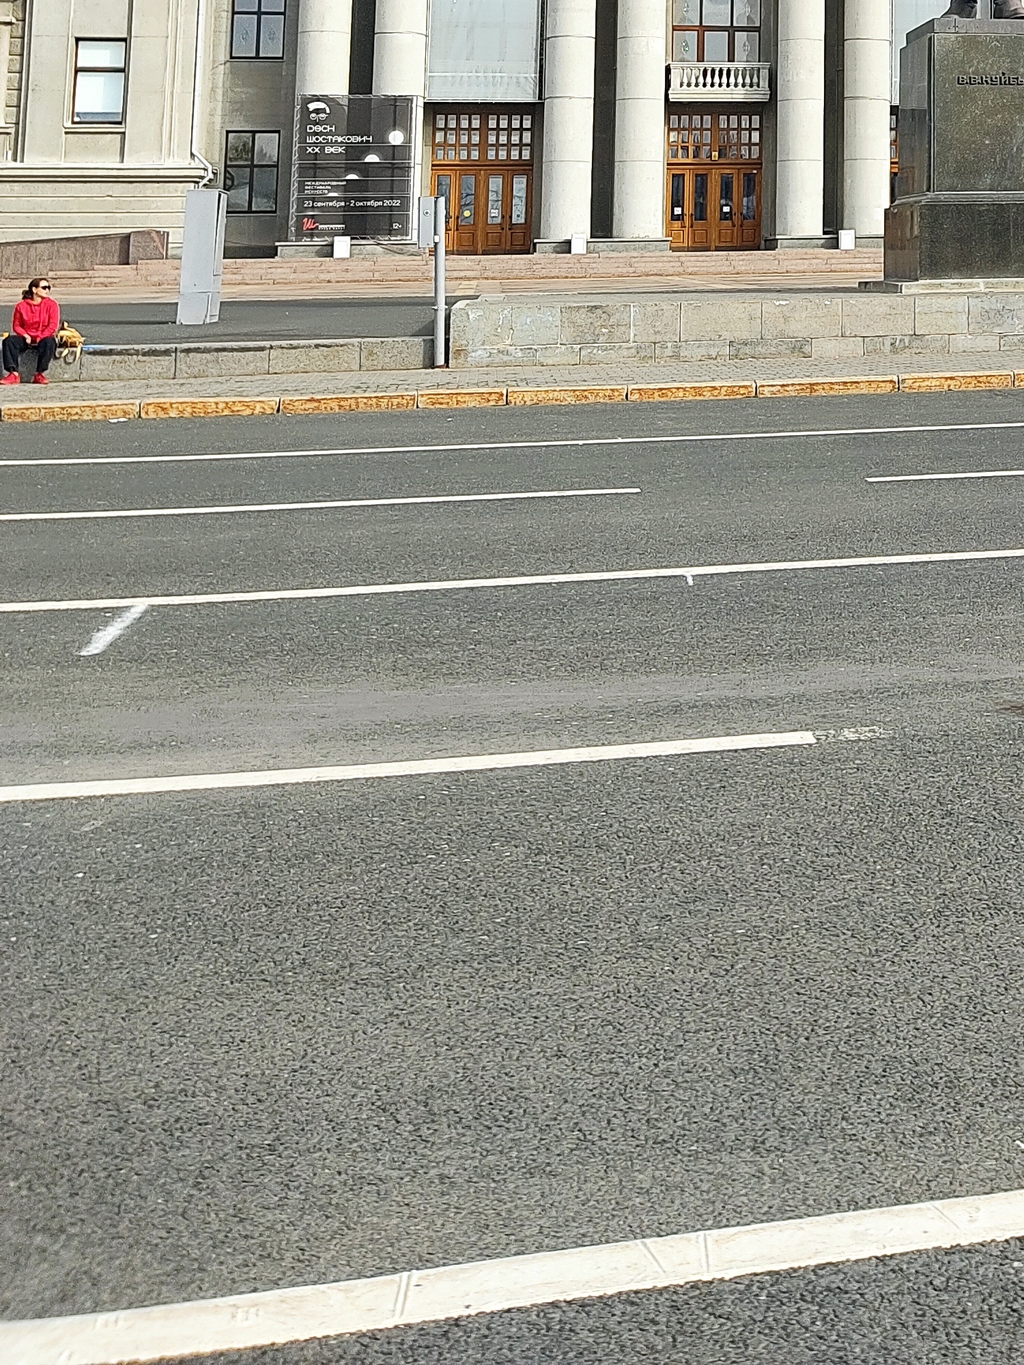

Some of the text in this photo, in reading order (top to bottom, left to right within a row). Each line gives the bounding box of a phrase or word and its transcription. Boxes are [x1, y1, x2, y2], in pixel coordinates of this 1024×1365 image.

[306, 135, 373, 143] ШОСТАКОВИЧ
[324, 146, 346, 154] ВЕК
[313, 199, 345, 208] сентября
[355, 199, 383, 207] октября
